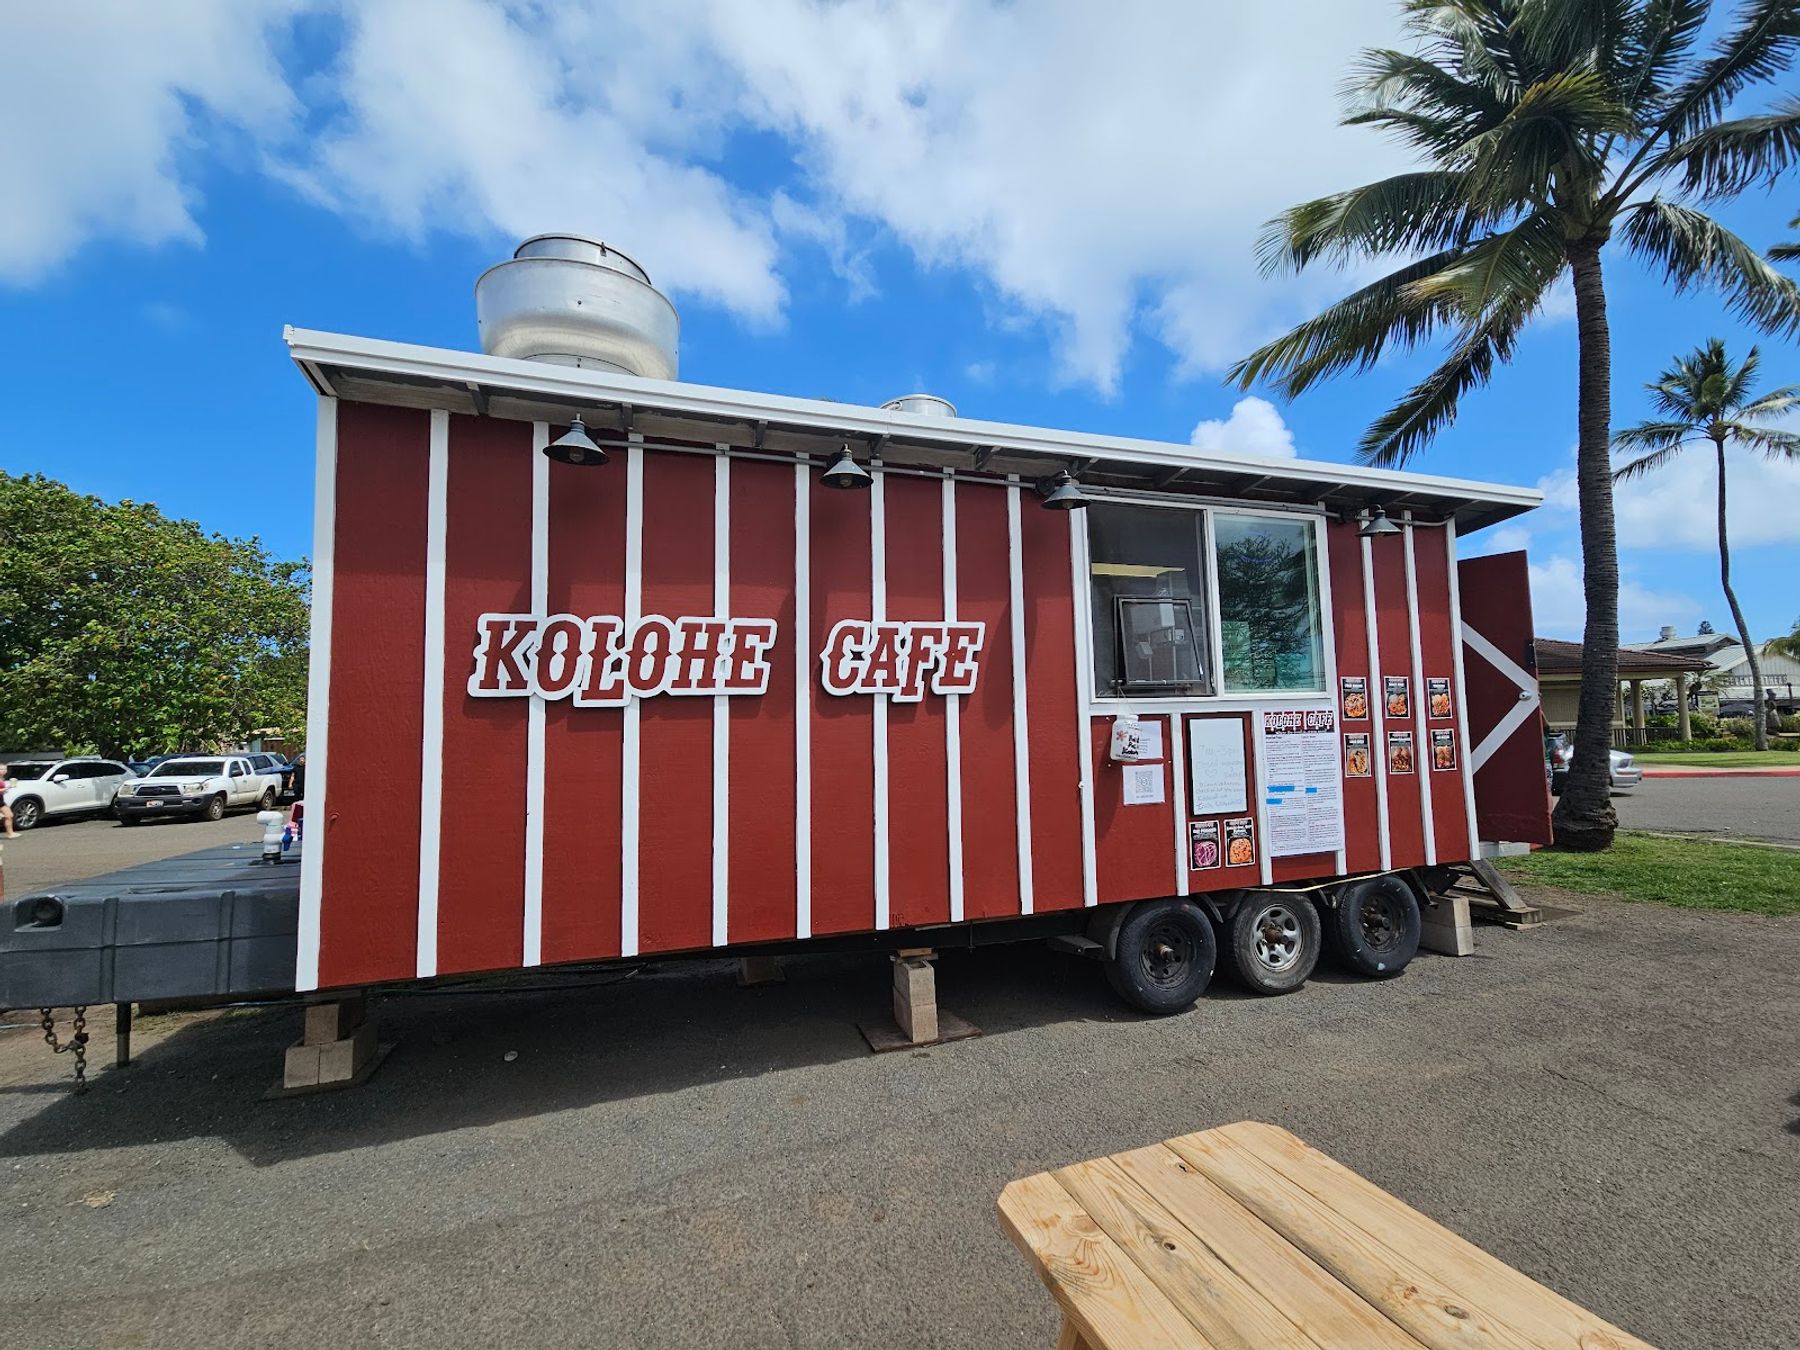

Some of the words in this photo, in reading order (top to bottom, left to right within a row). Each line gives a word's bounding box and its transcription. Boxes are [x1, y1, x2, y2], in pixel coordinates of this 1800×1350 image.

[472, 615, 775, 704] KOLOHE
[823, 621, 983, 701] CAFE
[1265, 714, 1302, 728] KOLOHE
[1308, 712, 1333, 726] CAFE
